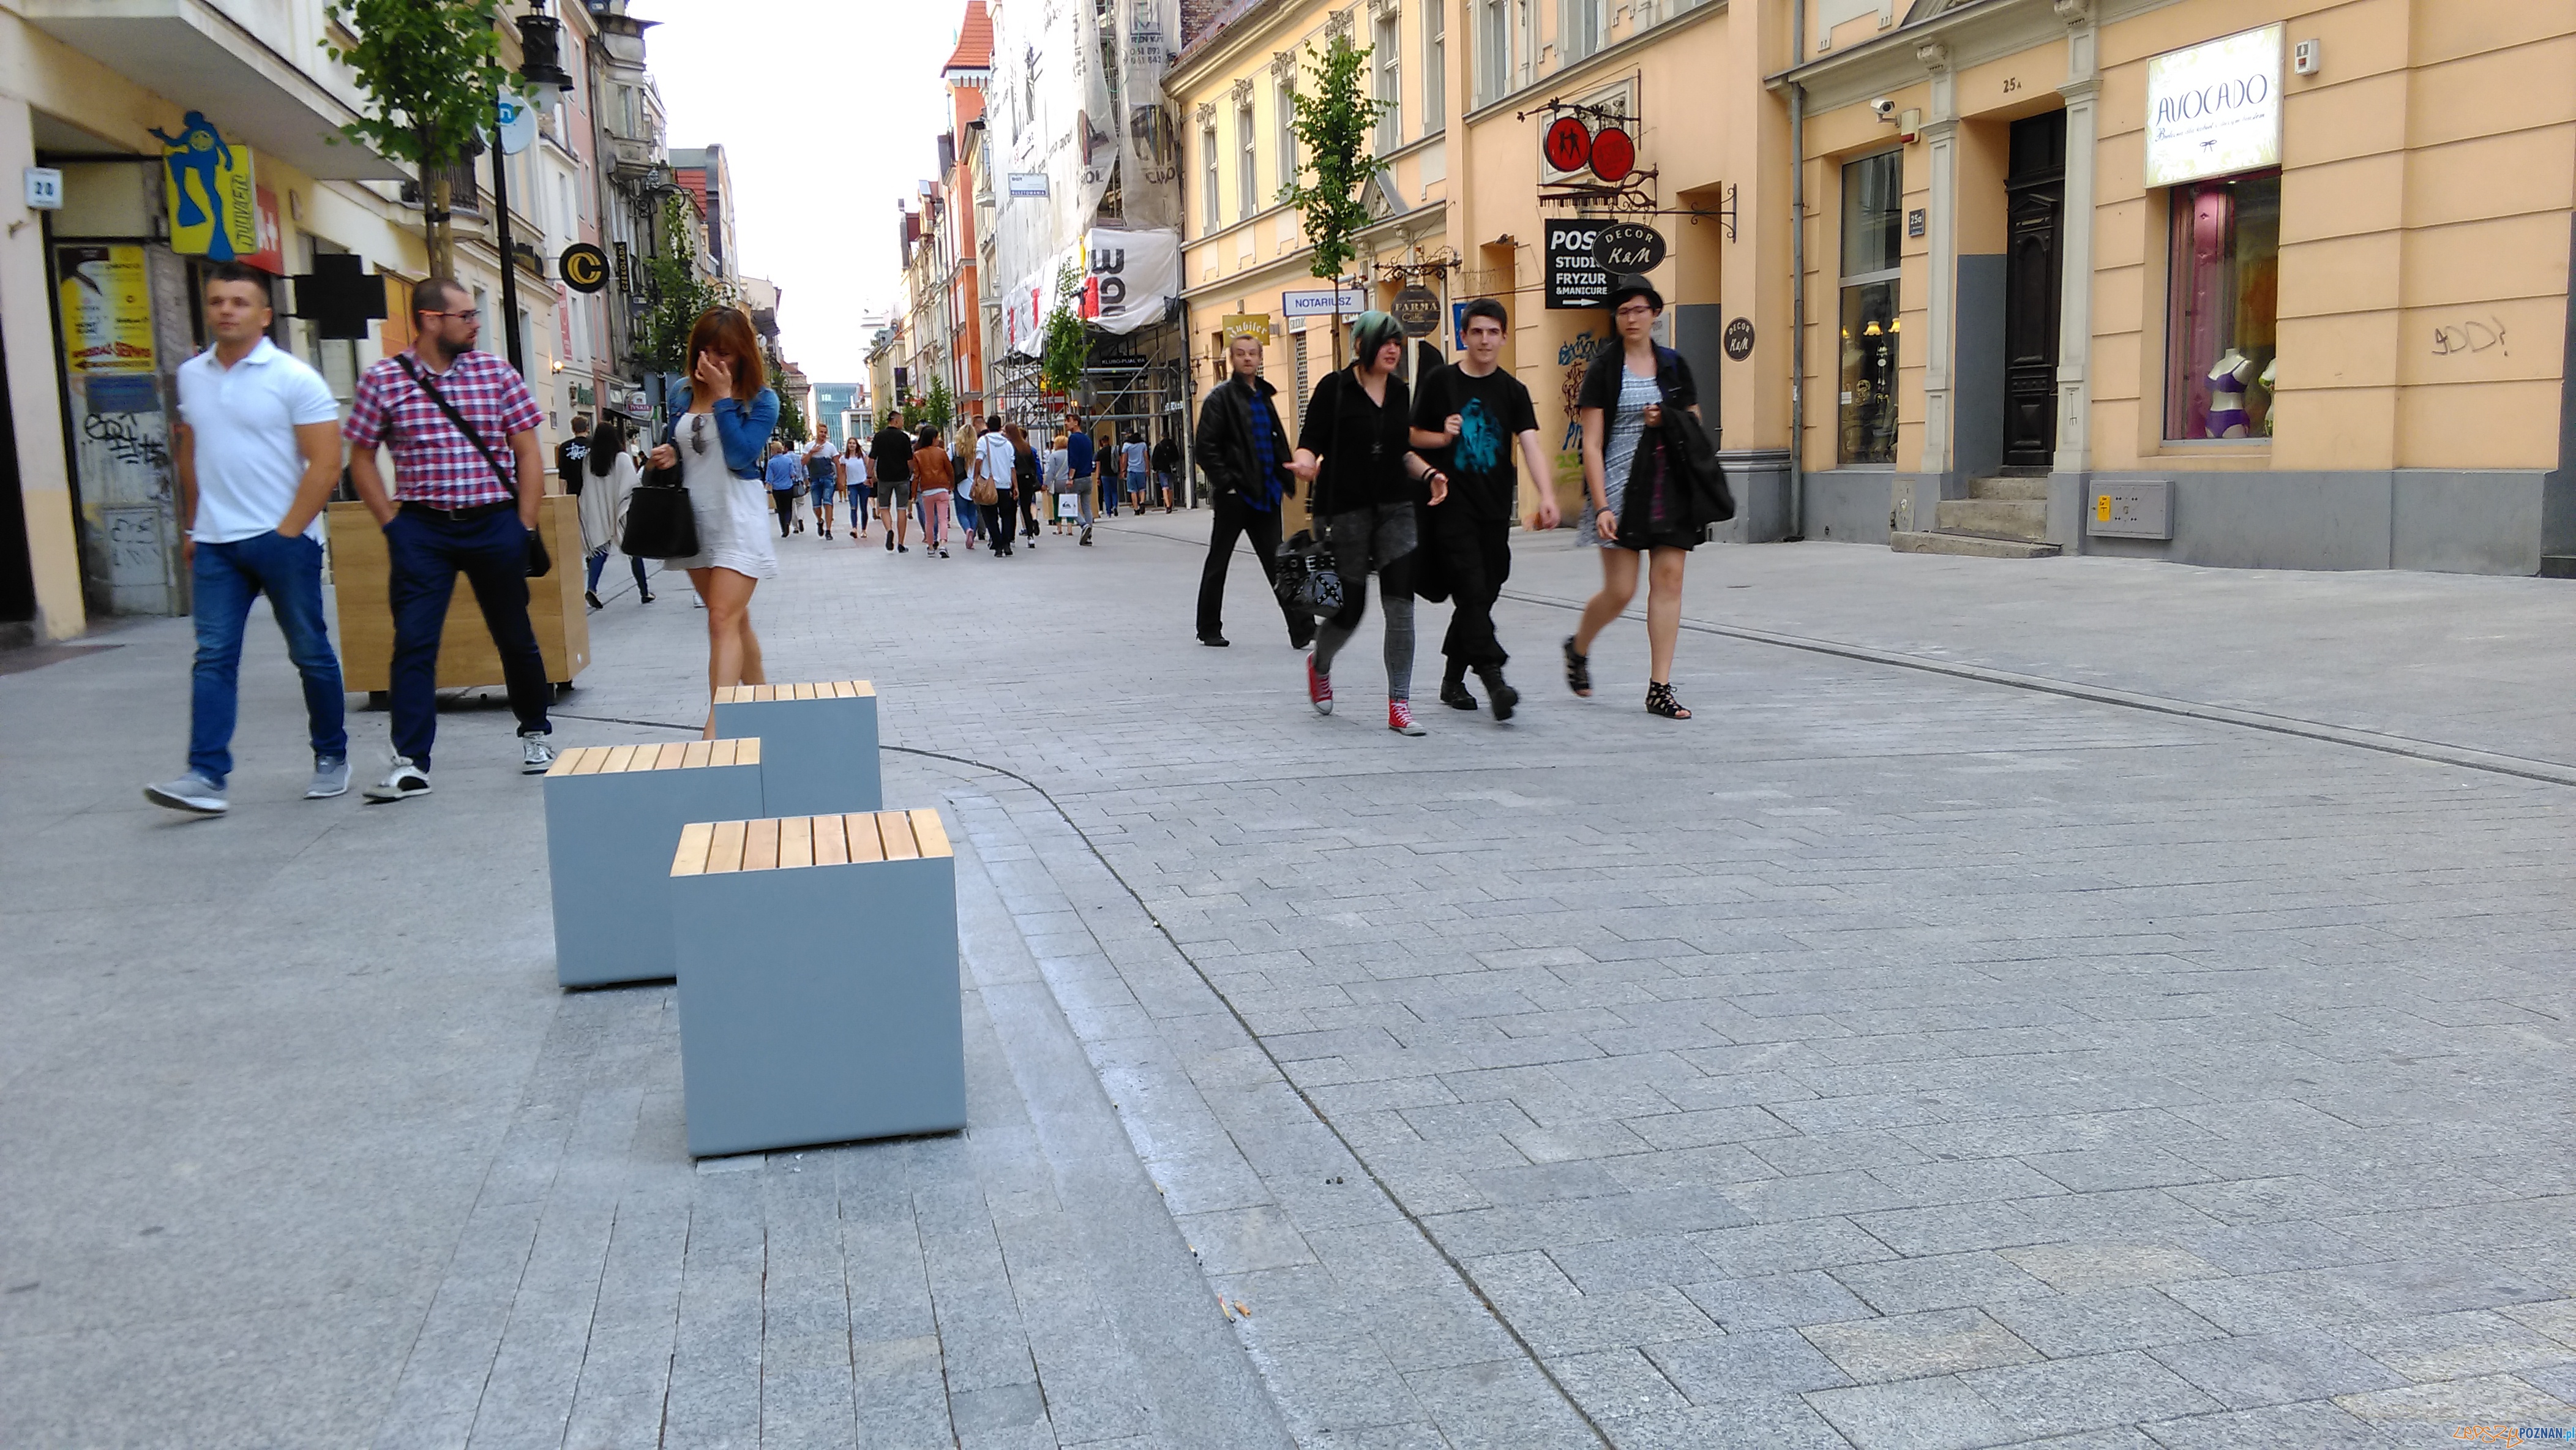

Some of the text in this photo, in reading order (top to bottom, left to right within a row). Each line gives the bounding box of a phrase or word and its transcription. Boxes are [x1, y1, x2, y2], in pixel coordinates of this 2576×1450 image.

[2156, 74, 2267, 126] AVOCADO
[1911, 214, 1922, 225] 25a
[1550, 230, 1600, 250] POS
[1605, 228, 1653, 243] DECOR
[1556, 256, 1600, 268] STUDI
[1608, 247, 1650, 266] K&M
[618, 244, 629, 291] CZEKOLADA
[1556, 272, 1607, 285] FRYZUR
[1556, 287, 1608, 295] &MANICURE
[1226, 321, 1267, 339] Jubiler
[1729, 321, 1750, 336] DECOR
